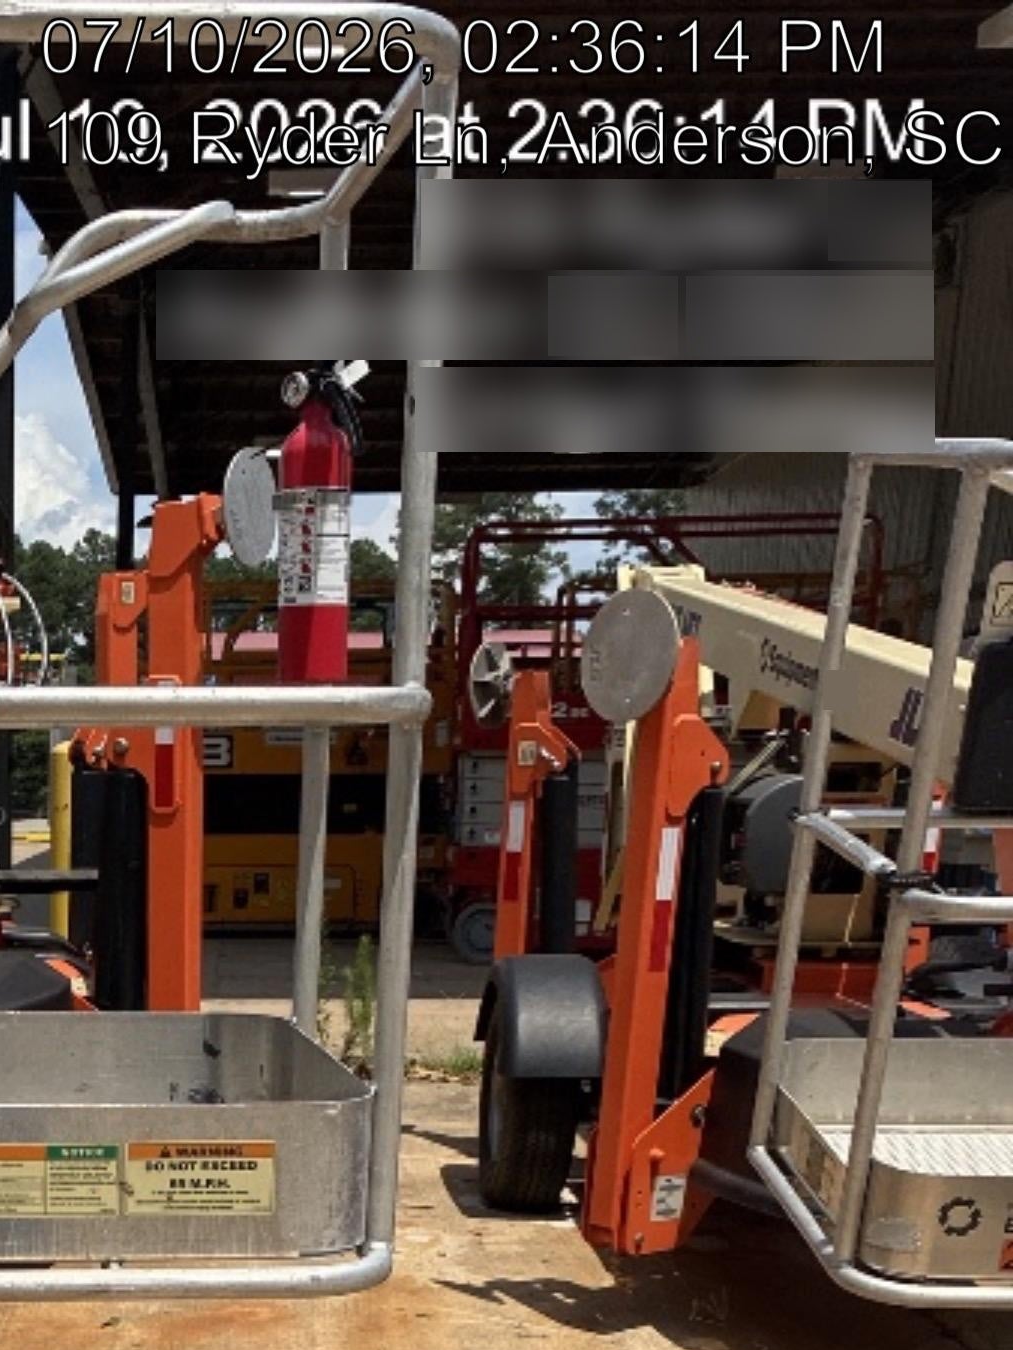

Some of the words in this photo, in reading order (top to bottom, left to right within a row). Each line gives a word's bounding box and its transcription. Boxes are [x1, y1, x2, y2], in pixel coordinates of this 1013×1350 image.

[889, 685, 928, 746] JL
[145, 1160, 165, 1172] DO
[167, 1160, 198, 1172] NOT
[200, 1160, 258, 1172] EXCEED
